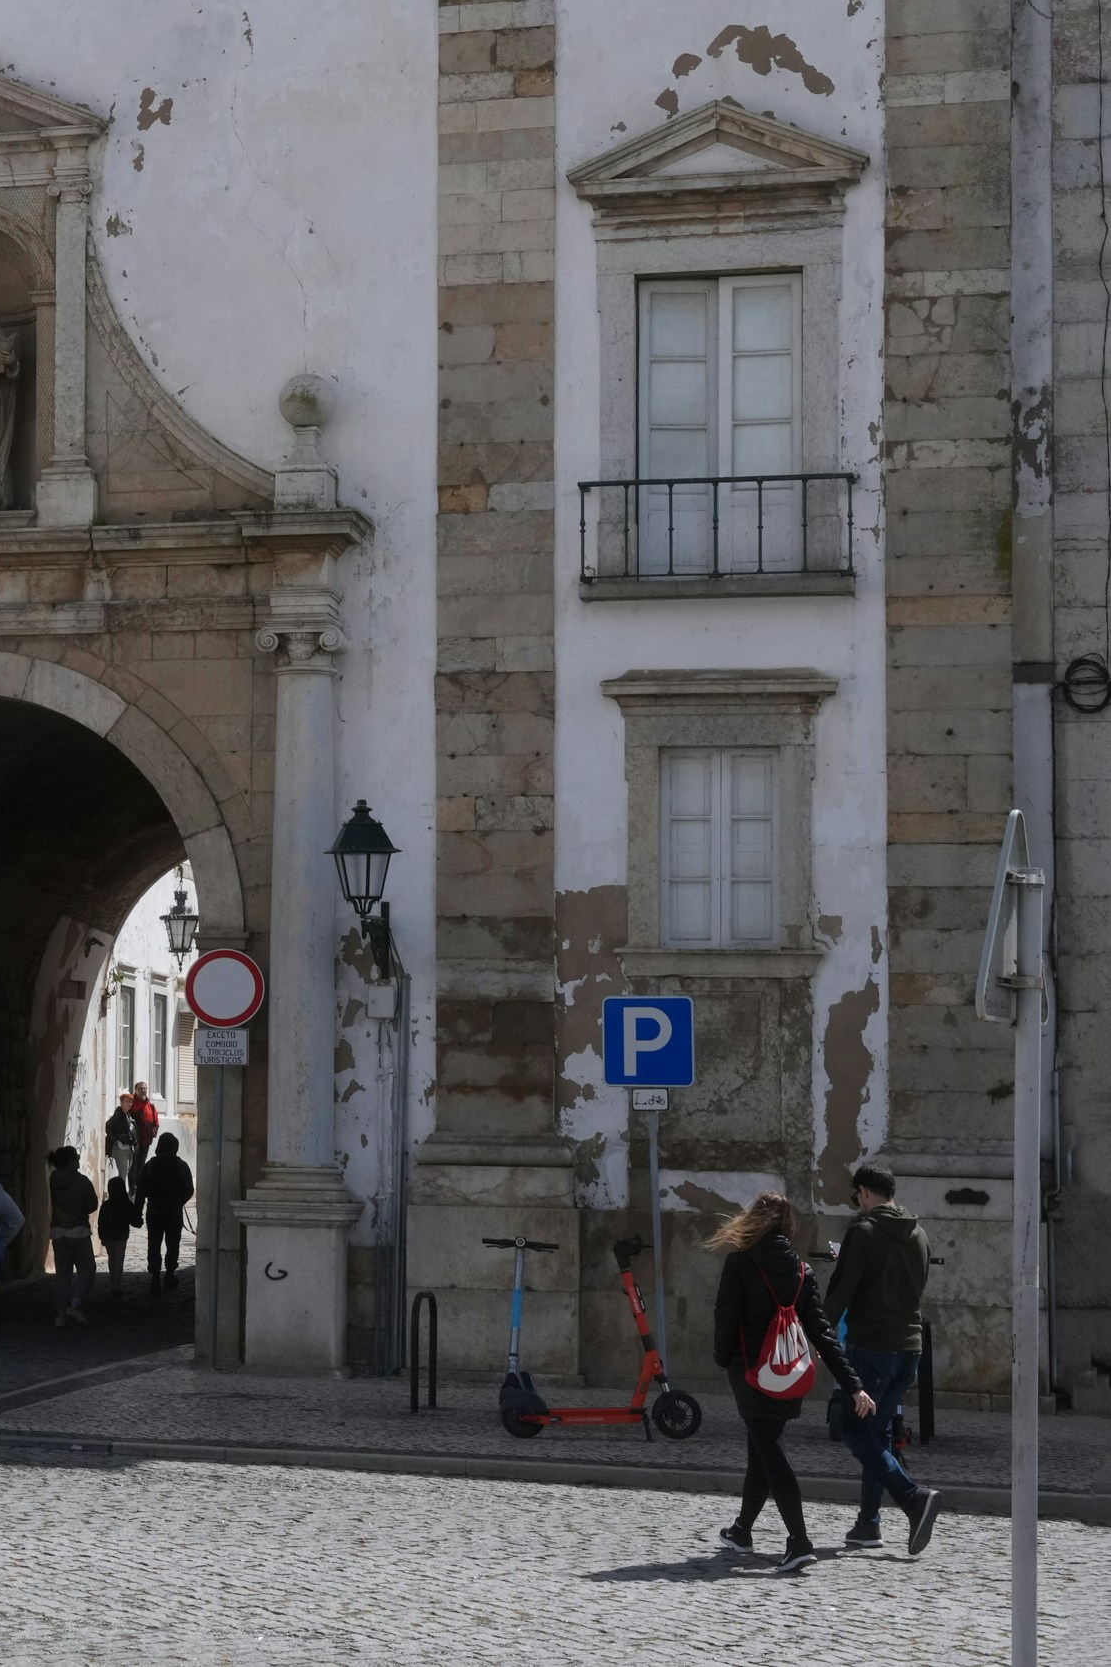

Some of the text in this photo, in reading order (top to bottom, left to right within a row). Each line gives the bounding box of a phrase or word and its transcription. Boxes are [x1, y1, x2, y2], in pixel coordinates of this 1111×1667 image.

[207, 1030, 236, 1039] EXCETO
[205, 1040, 238, 1048] COMBOIO
[623, 1006, 673, 1077] P
[197, 1048, 244, 1057] E TRICICLOS
